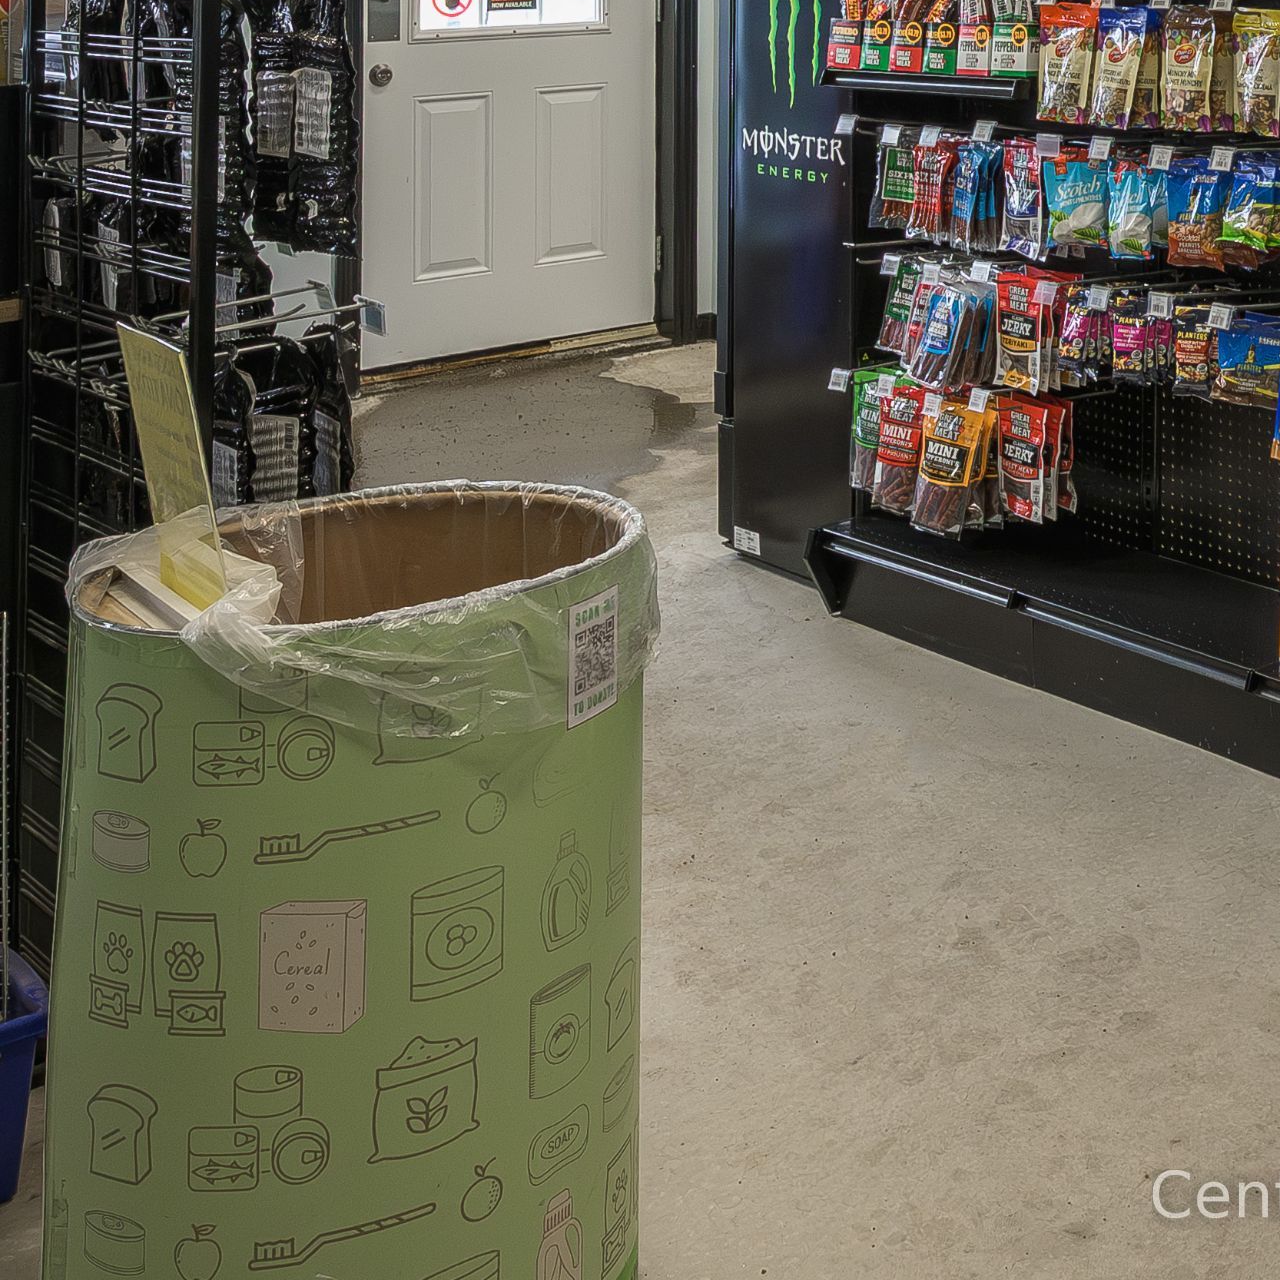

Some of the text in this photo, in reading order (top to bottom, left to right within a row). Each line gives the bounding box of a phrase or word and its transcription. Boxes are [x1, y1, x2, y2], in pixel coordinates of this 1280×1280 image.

[742, 125, 846, 166] MONSTER
[757, 164, 829, 184] ENERGY
[1009, 286, 1029, 297] GREAT
[1009, 300, 1029, 312] MEAT
[1001, 318, 1033, 336] JERKY
[1177, 330, 1208, 341] PLANTERS
[1010, 411, 1031, 423] GREAT
[883, 424, 912, 439] MINI
[934, 428, 960, 441] MEAT
[1011, 425, 1031, 437] MEAT
[927, 441, 960, 460] MINI
[1004, 444, 1034, 464] JERKY
[575, 605, 600, 627] SCAN
[574, 682, 615, 717] TO DONATE
[273, 949, 333, 980] Cereal
[544, 1125, 576, 1156] SOAP
